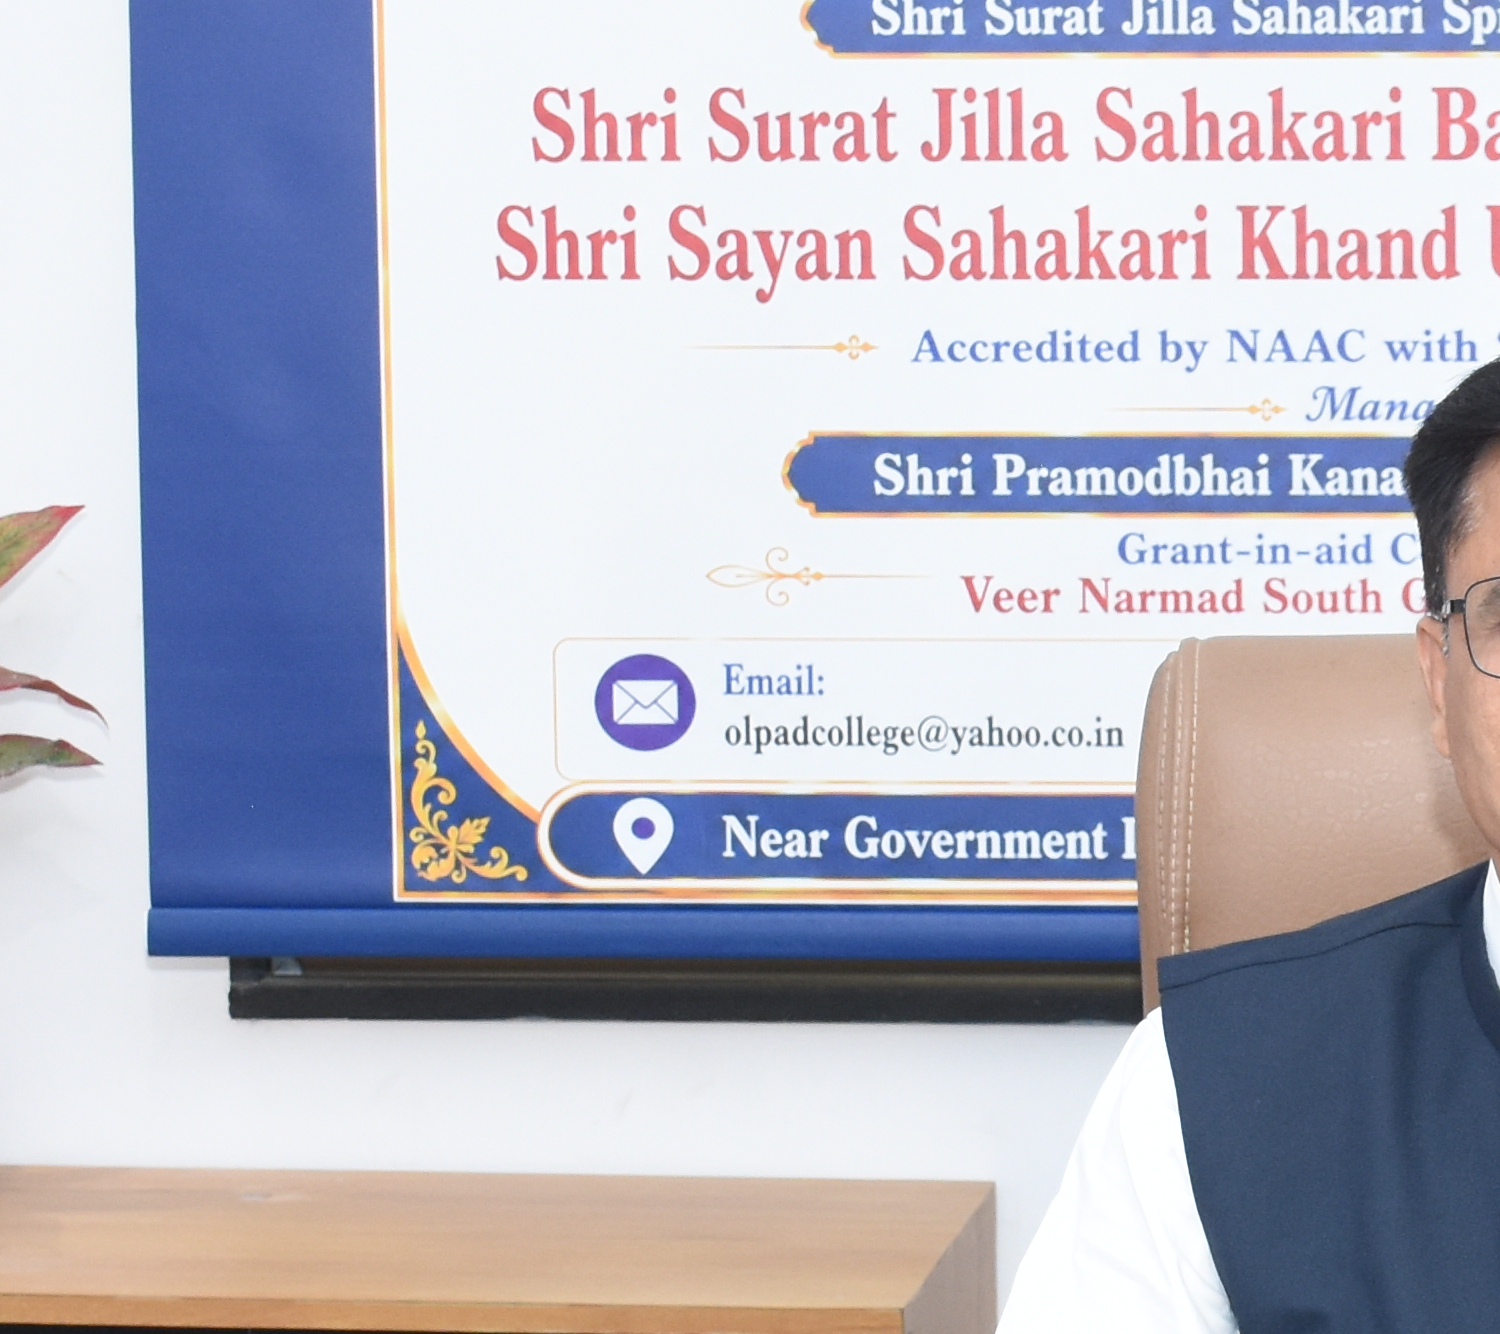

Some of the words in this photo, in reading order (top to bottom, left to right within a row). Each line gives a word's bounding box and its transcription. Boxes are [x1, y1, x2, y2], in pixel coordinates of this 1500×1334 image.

[533, 87, 680, 163] Shri
[709, 87, 898, 162] Surat
[922, 88, 1068, 162] Jilla
[1096, 87, 1405, 162] Sahakari
[497, 205, 640, 281] Shri
[669, 205, 876, 303] Sayan
[904, 205, 1210, 281] Sahakari
[1238, 206, 1459, 280] Khand
[913, 330, 1140, 362] Accredited
[1160, 330, 1207, 373] by
[1228, 329, 1364, 362] NAAC
[1385, 330, 1478, 362] with
[1308, 386, 1434, 421] Mana
[874, 453, 975, 495] Shri
[993, 454, 1271, 495] Pramodbhai
[1289, 454, 1403, 496] Kana
[1118, 533, 1373, 565] Grant-in-aid
[963, 576, 1060, 613] Veer
[1082, 578, 1244, 613] Narmad
[1265, 579, 1382, 613] South
[724, 664, 823, 695] Email:
[725, 715, 1123, 755] olpadcollege@yahoo.co.in
[723, 815, 829, 857] Near
[845, 816, 1107, 859] Government
